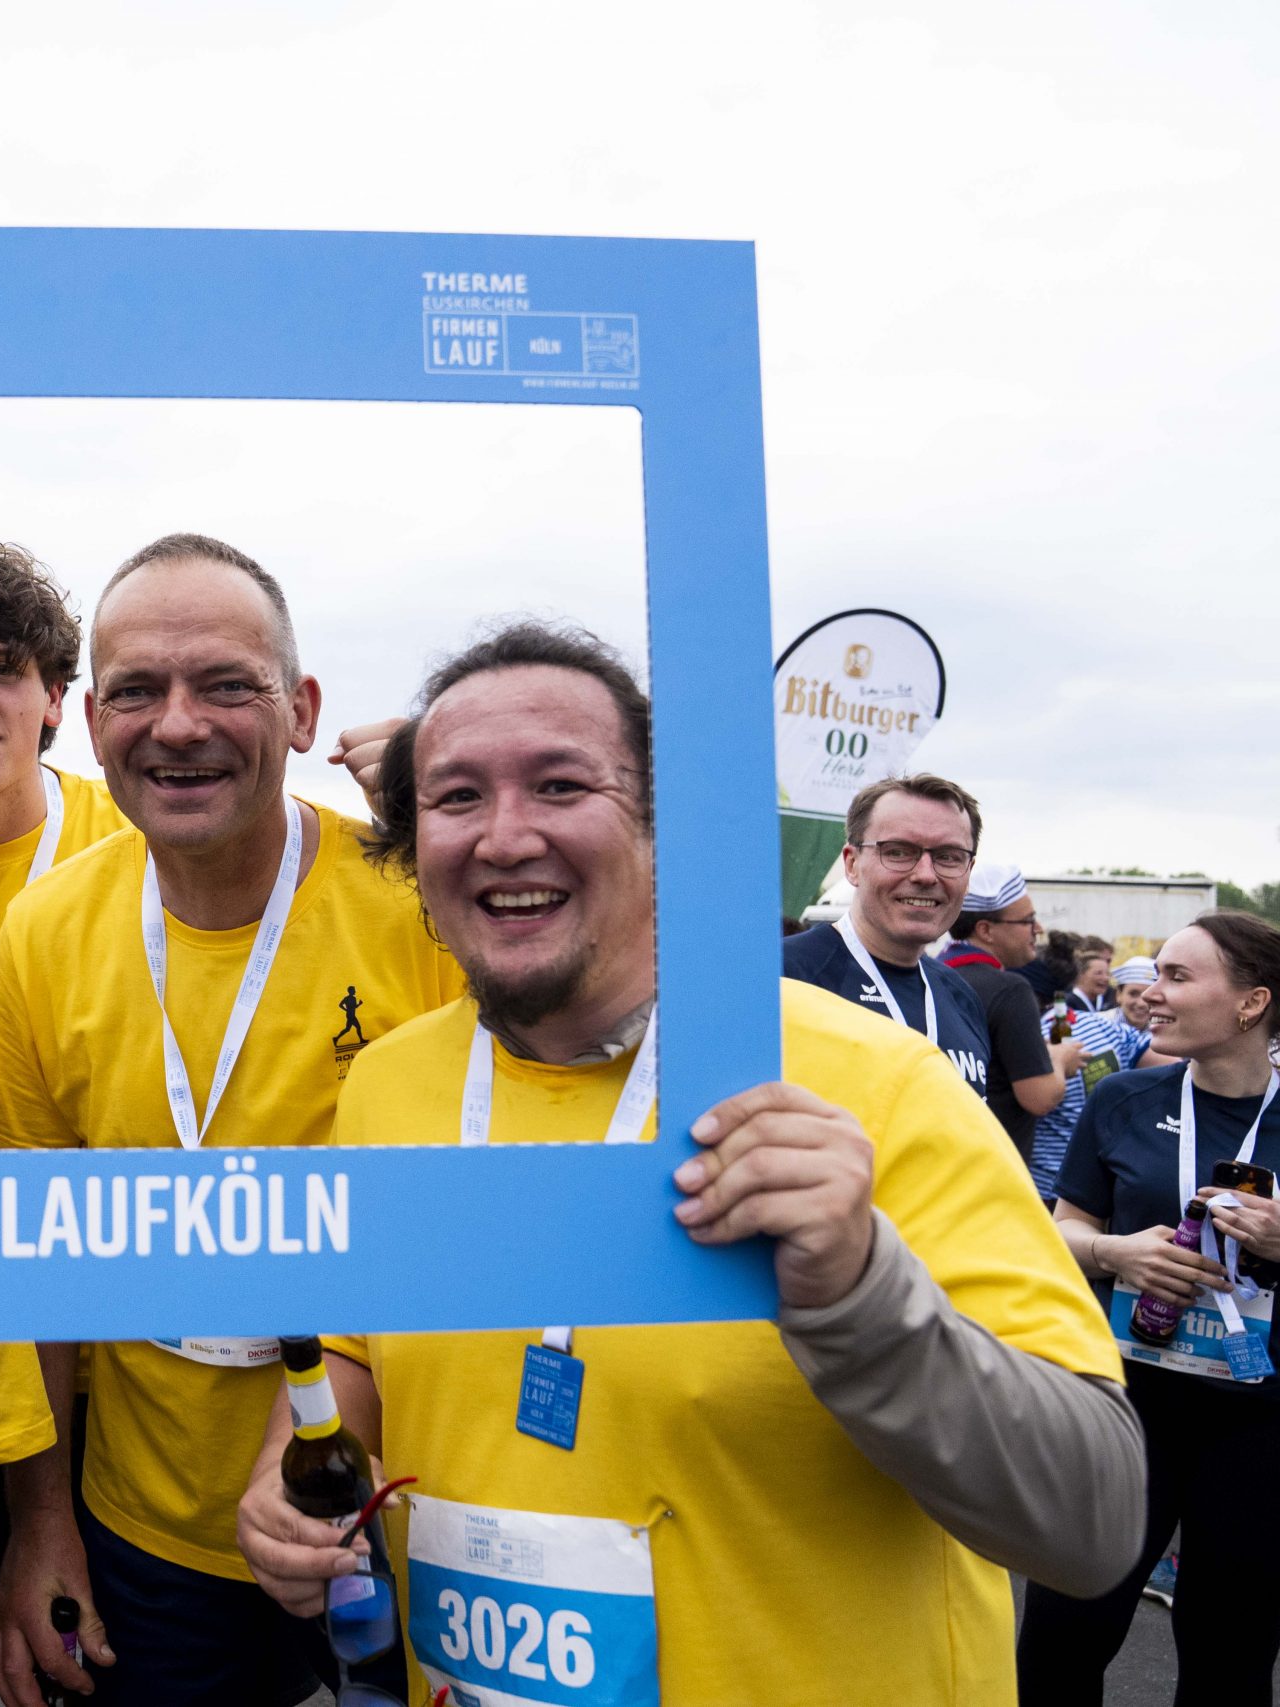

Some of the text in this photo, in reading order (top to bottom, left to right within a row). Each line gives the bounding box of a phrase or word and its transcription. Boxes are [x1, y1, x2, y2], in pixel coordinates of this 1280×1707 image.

[422, 272, 528, 294] THERME
[423, 296, 529, 312] EUSKIRCHEN
[432, 318, 499, 337] FIRMEN
[432, 339, 499, 366] LAUF
[529, 337, 562, 355] KÖLN
[782, 675, 919, 735] Bitburger
[825, 729, 868, 760] 0.0
[265, 924, 279, 952] THERME
[247, 1348, 272, 1358] DKMS
[527, 1351, 561, 1370] THERME
[527, 1374, 555, 1391] FIRMEN
[525, 1385, 553, 1406] LAUF
[465, 1513, 498, 1527] THERME
[468, 1546, 490, 1560] LAUF
[438, 1588, 595, 1690] 3026
